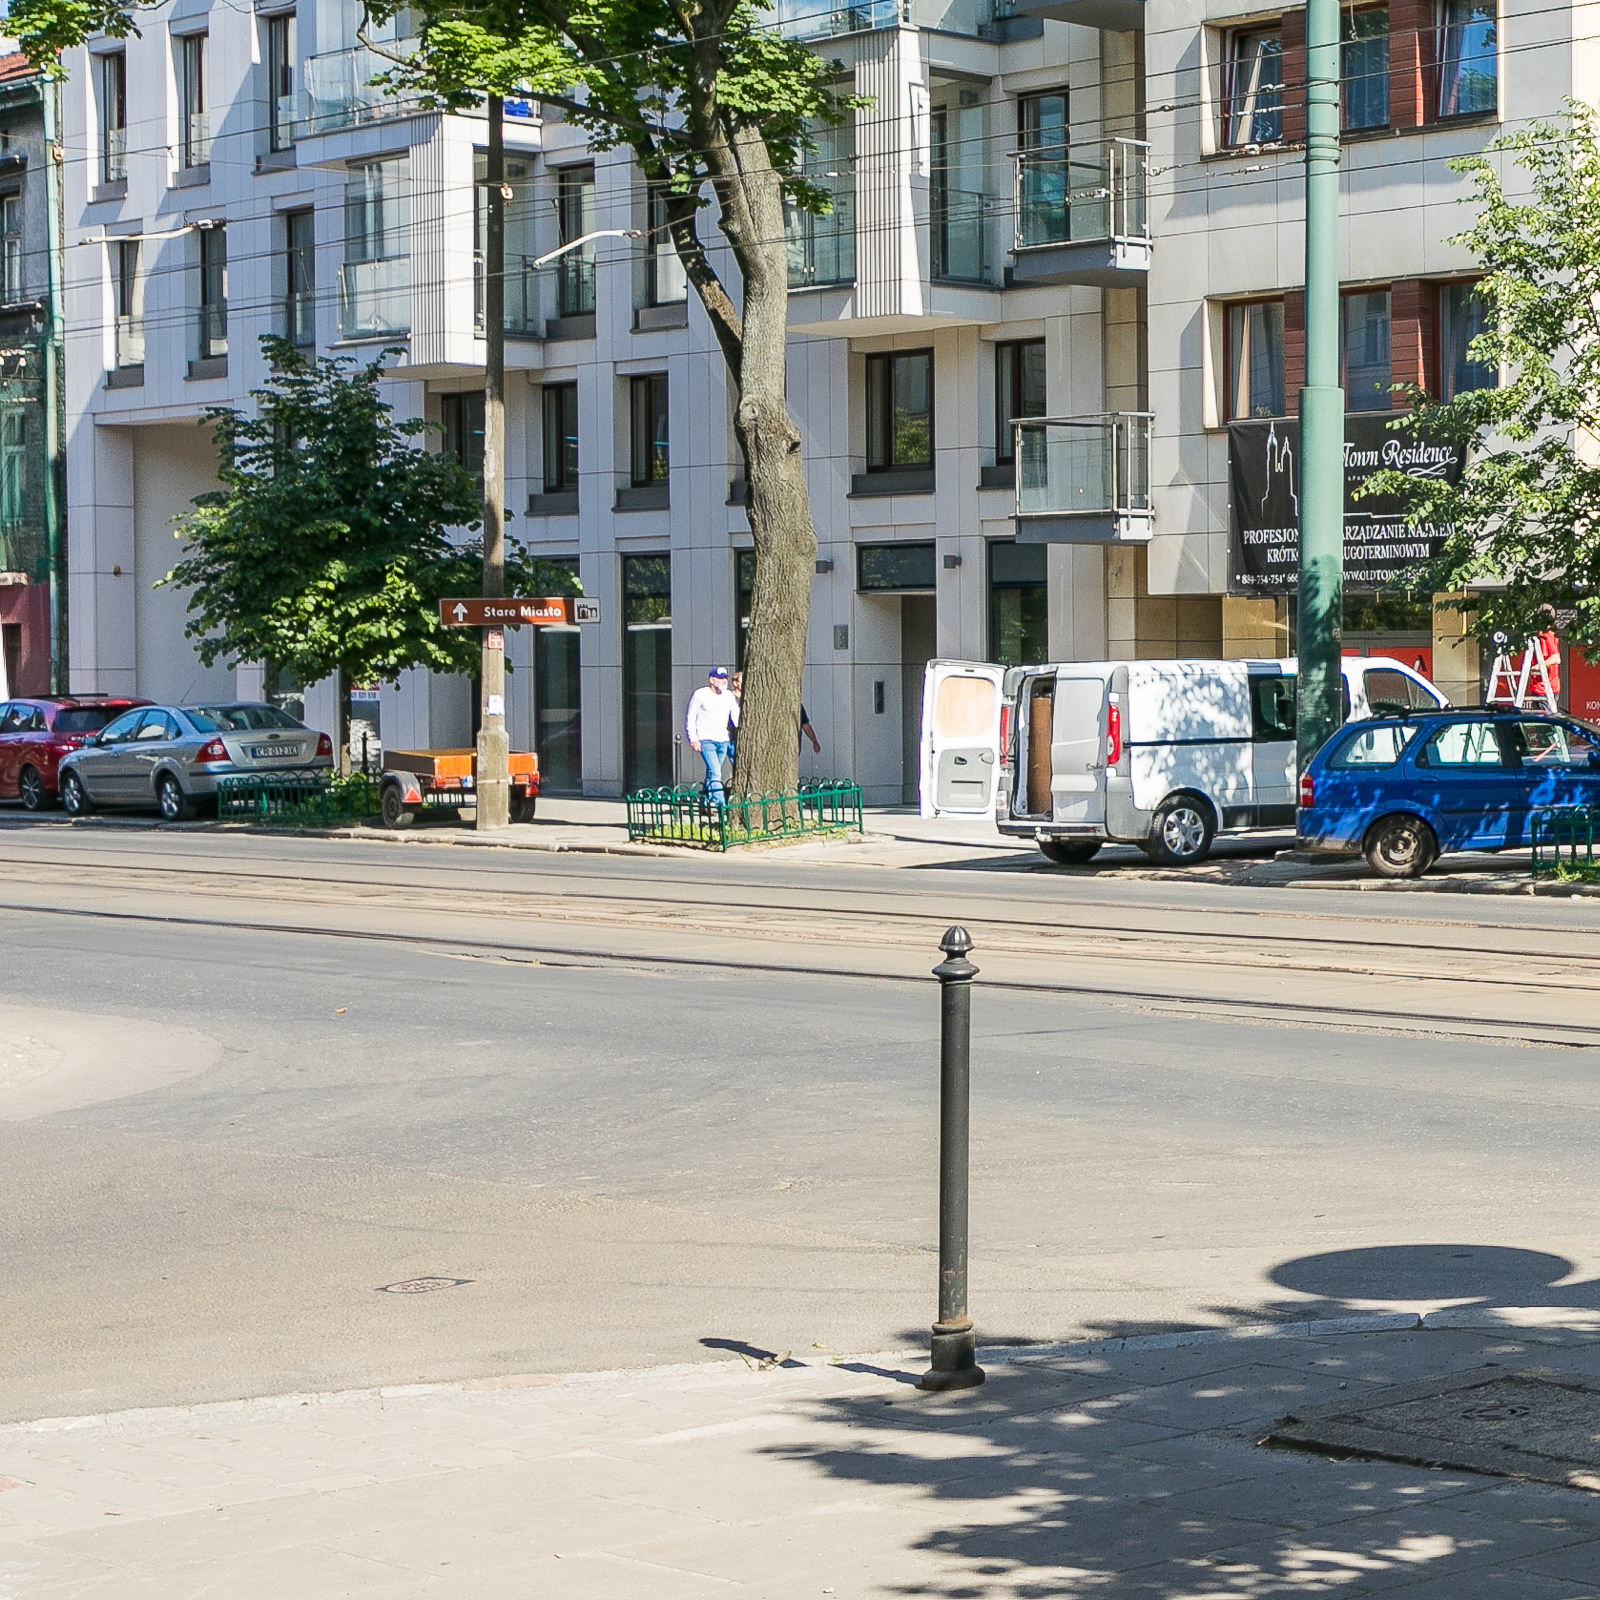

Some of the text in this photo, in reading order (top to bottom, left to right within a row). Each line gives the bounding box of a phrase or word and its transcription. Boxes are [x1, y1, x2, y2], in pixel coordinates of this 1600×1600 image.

[1382, 440, 1457, 470] Residence
[1343, 543, 1430, 560] UGOTERMINOWYM
[484, 605, 562, 617] Stare Miasto
